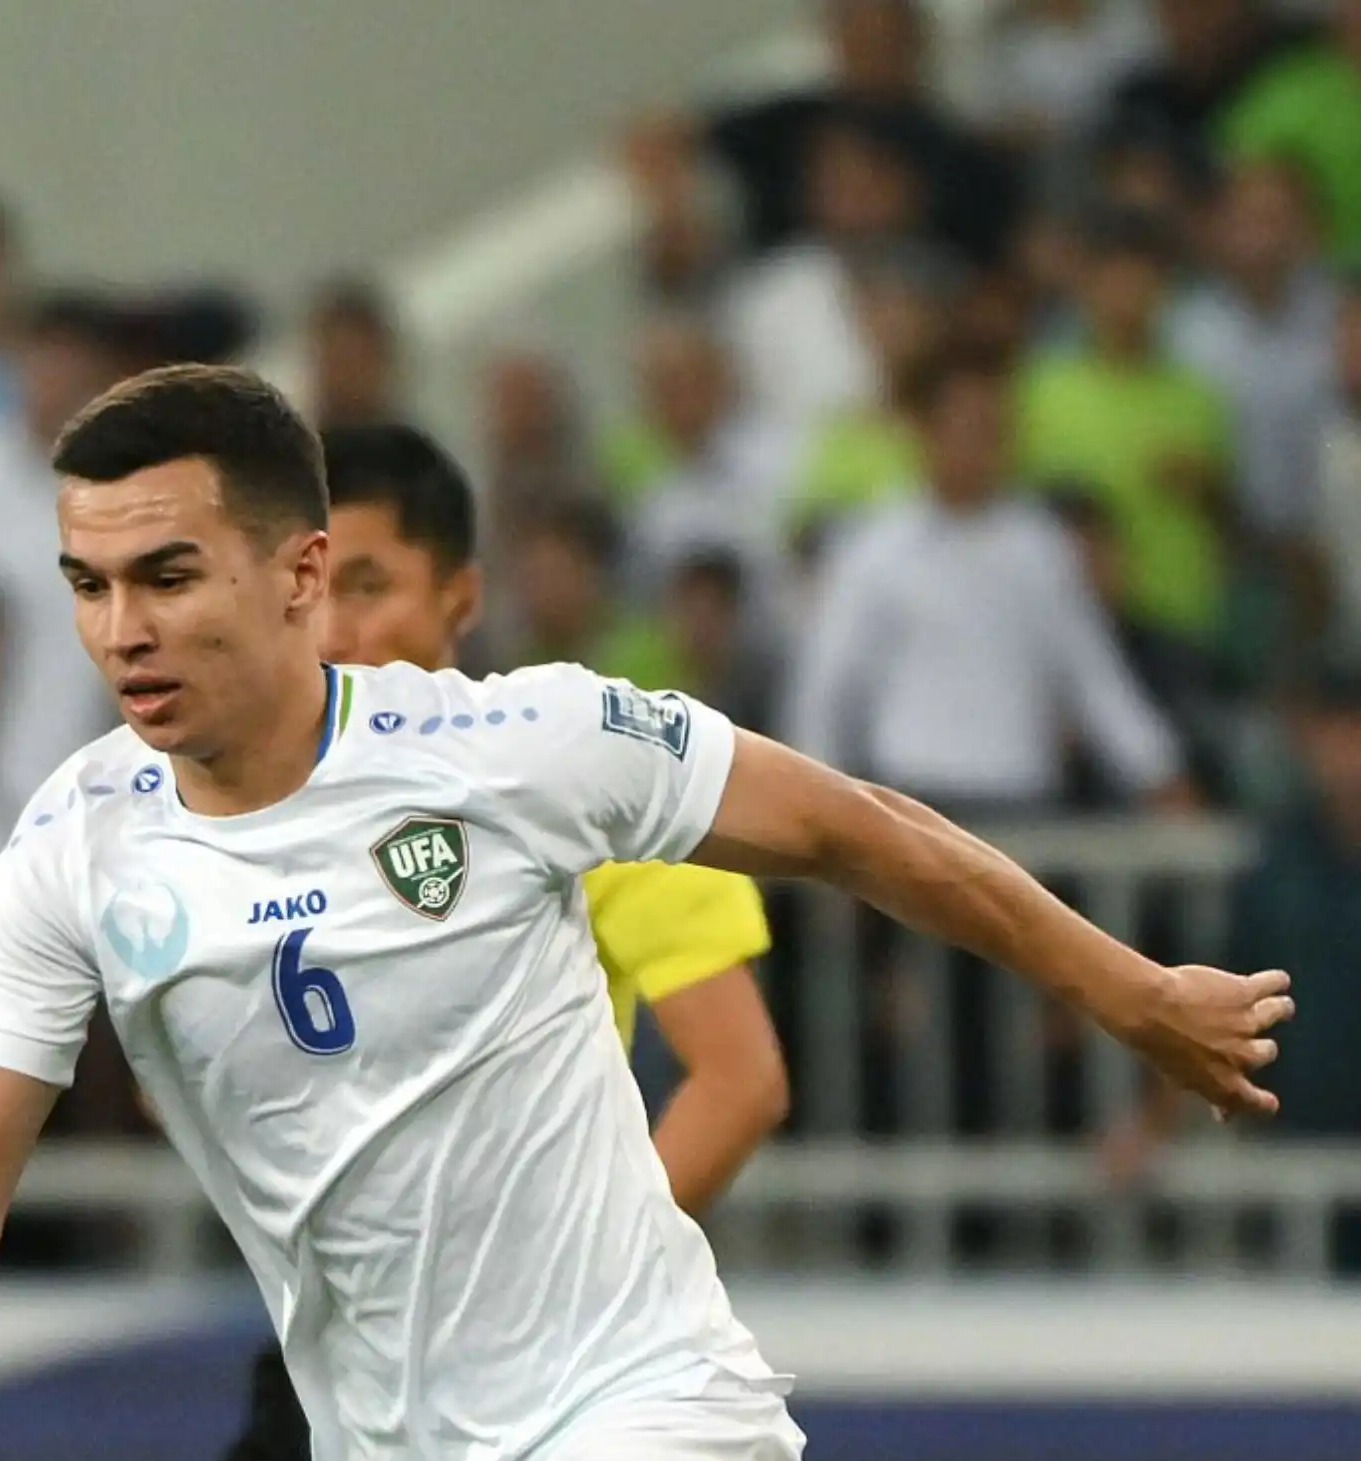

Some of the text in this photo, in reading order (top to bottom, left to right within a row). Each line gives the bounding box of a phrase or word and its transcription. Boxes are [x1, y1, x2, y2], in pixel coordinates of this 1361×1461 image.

[389, 833, 458, 878] UFA
[247, 889, 328, 925] JAKO
[271, 927, 355, 1056] 6
